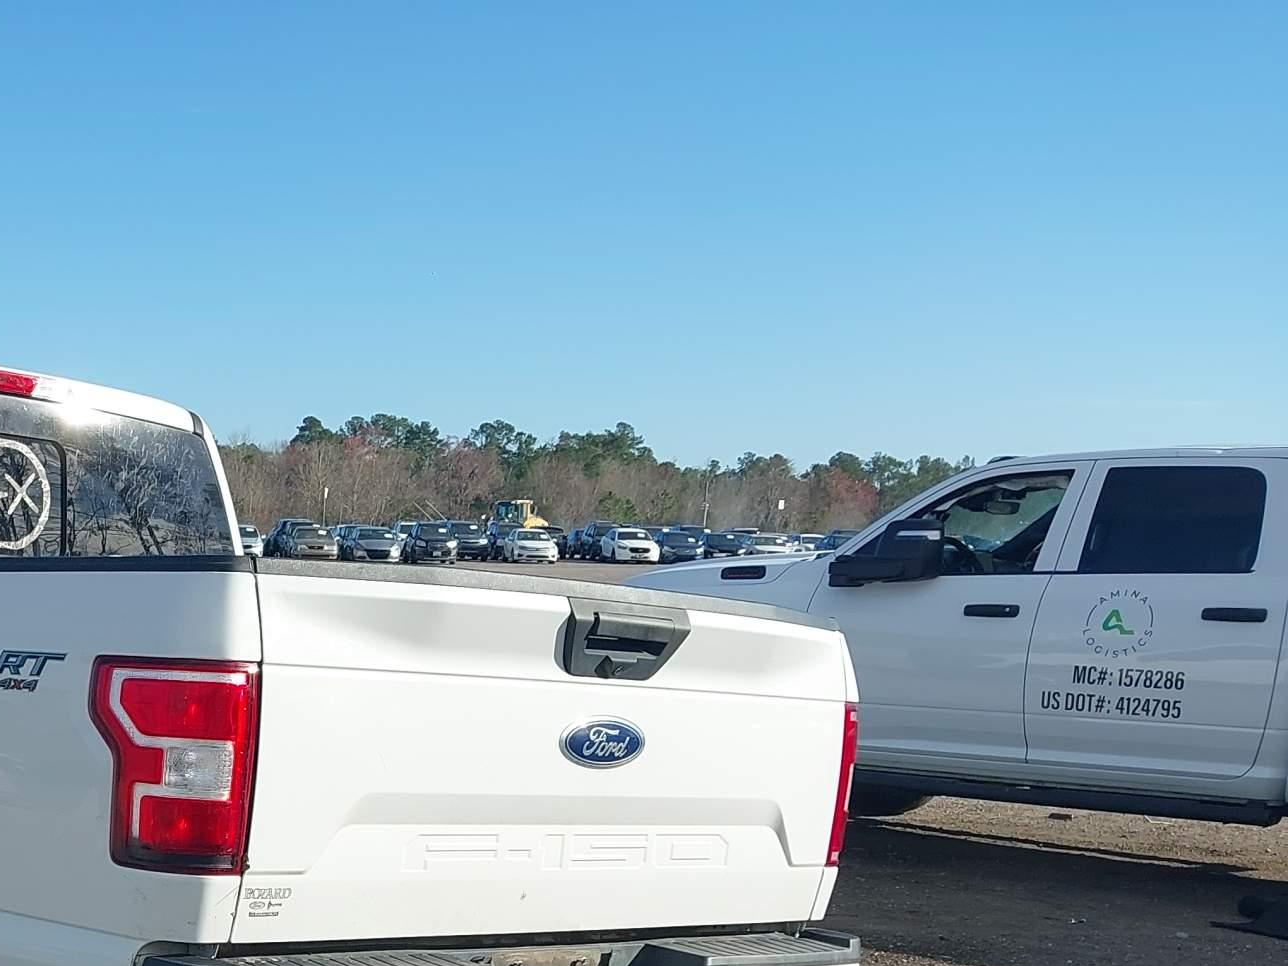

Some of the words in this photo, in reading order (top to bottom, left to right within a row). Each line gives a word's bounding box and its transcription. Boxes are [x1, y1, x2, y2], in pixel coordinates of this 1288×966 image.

[1099, 589, 1149, 605] AMINA
[1082, 628, 1153, 659] LOGISTICS
[1072, 665, 1113, 687] MC#:
[1117, 668, 1186, 691] 1578286
[1041, 690, 1061, 711] US
[1064, 692, 1111, 715] DOT#:
[1115, 696, 1182, 719] 4124795
[582, 726, 629, 758] Ford
[401, 833, 730, 872] F-150
